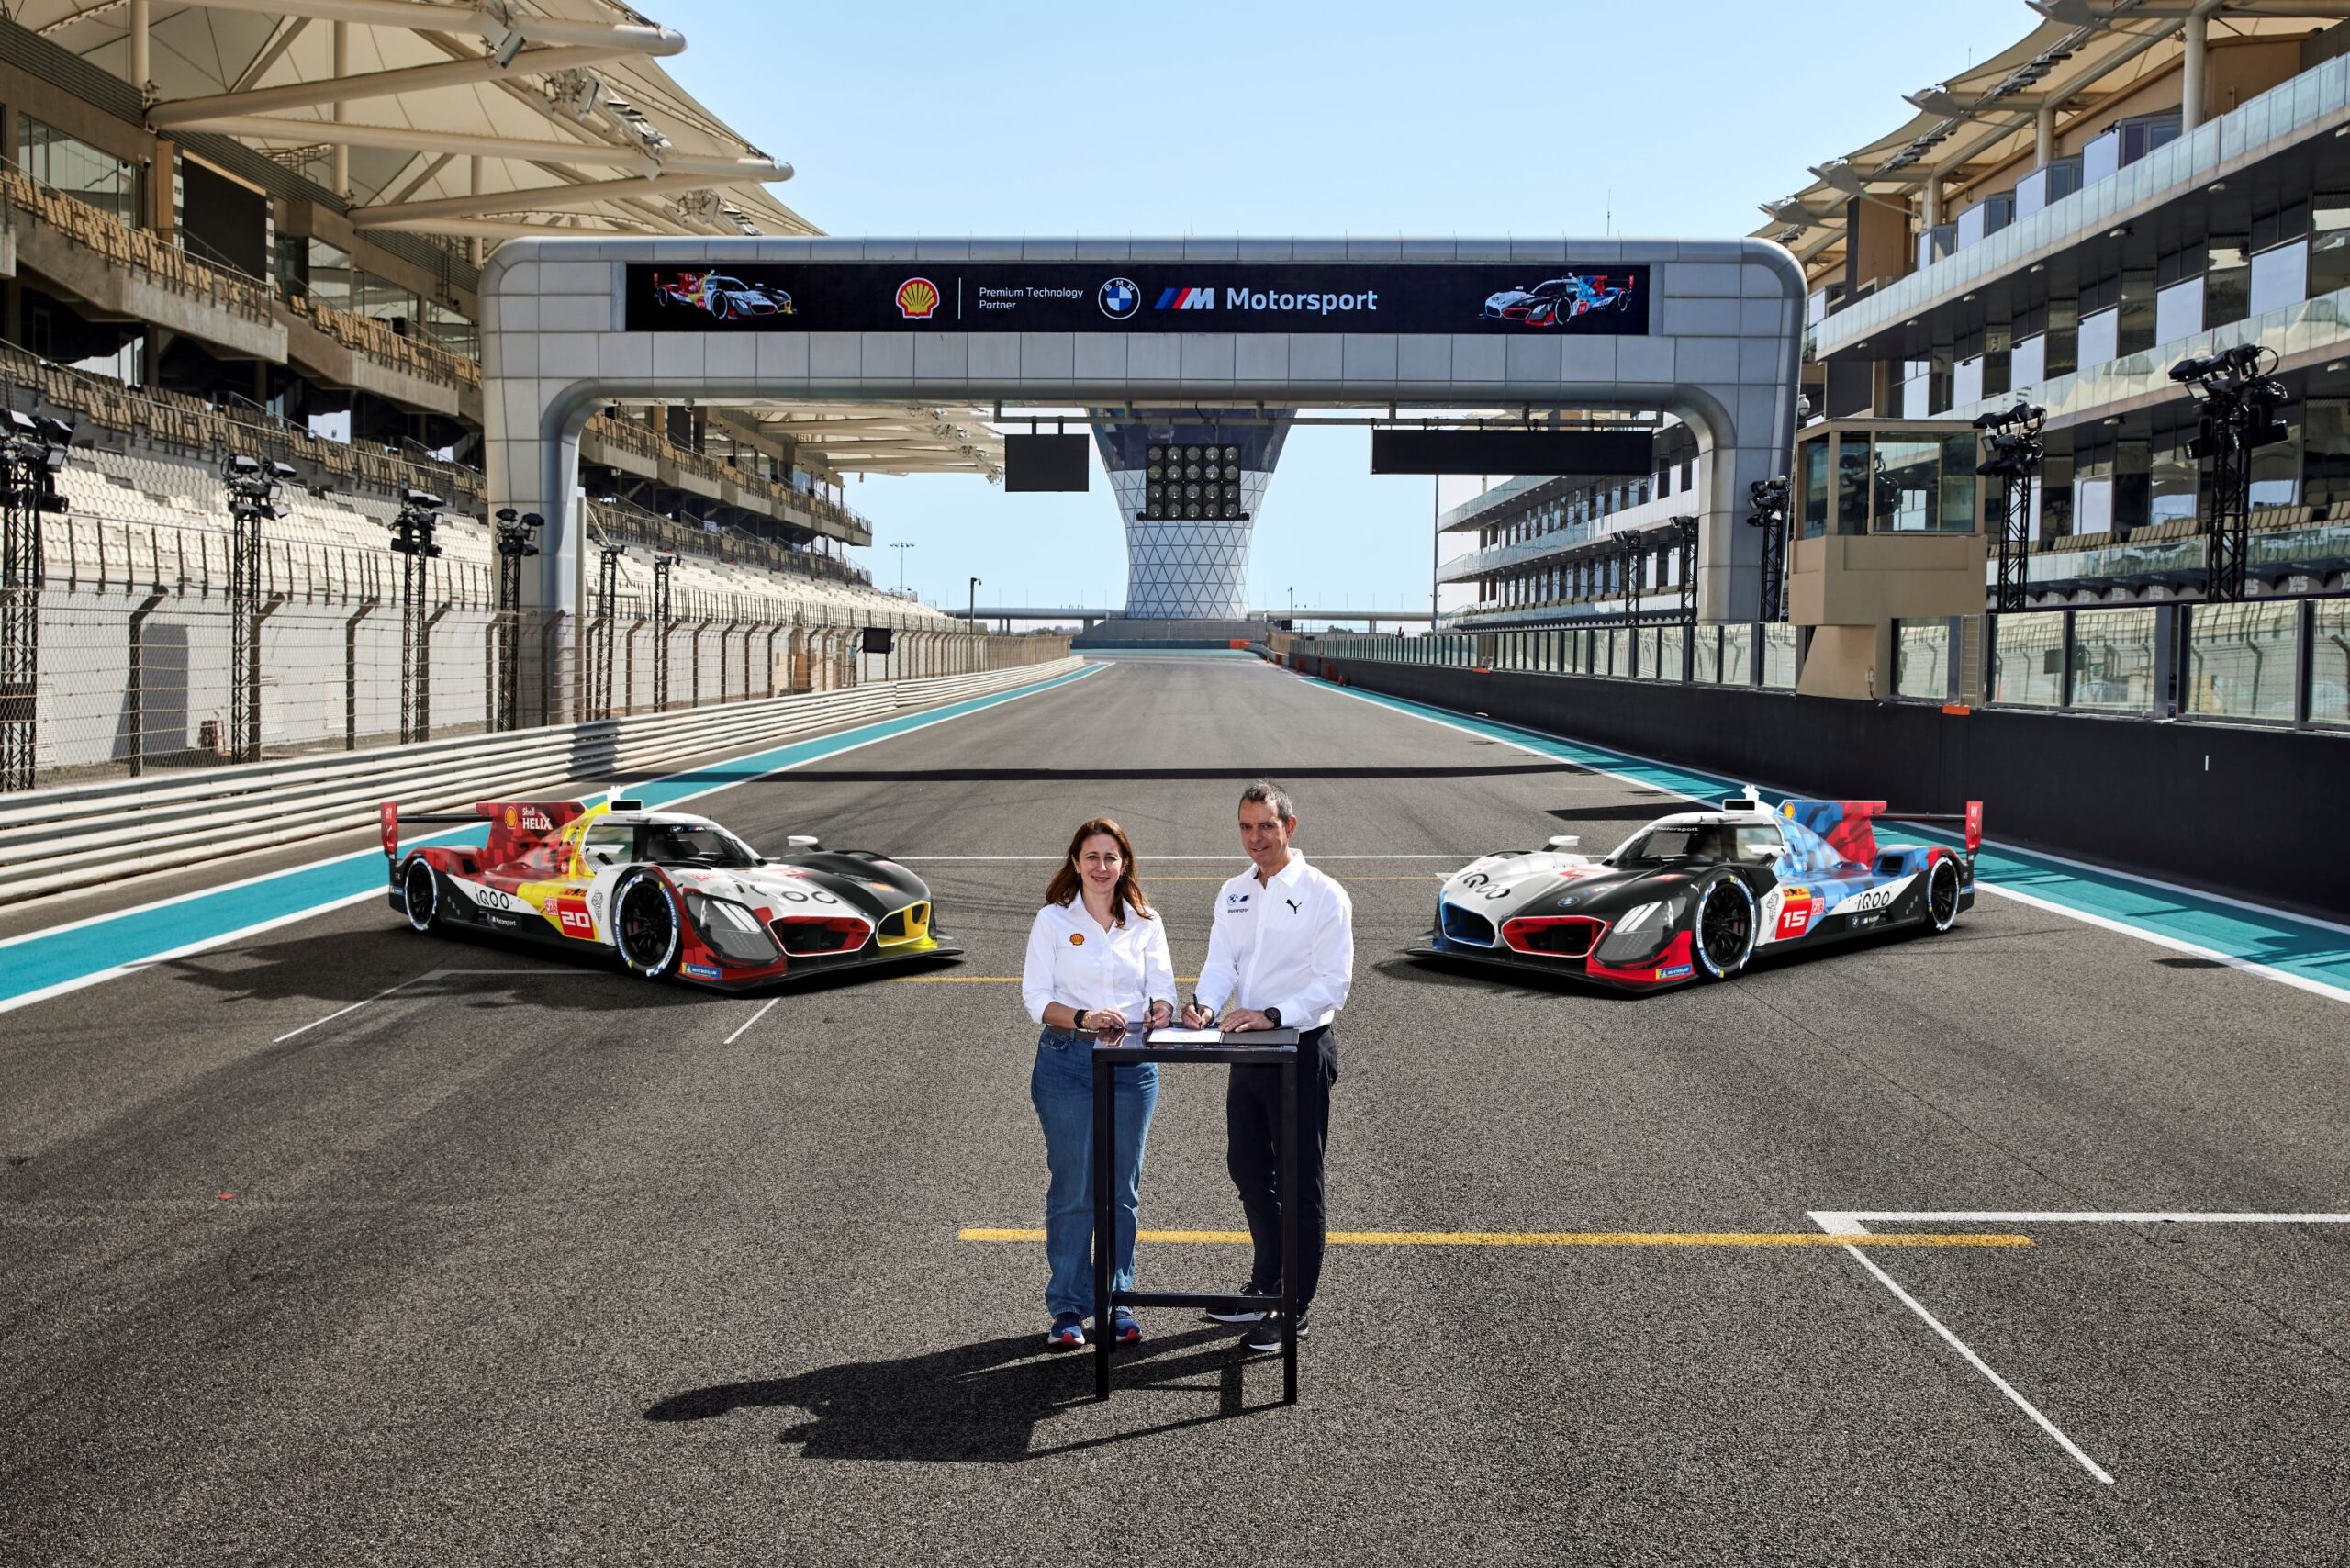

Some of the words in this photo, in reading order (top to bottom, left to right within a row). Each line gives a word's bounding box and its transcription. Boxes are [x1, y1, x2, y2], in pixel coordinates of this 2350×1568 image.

[979, 286, 1024, 297] Premium
[1025, 286, 1084, 299] Technology
[1226, 287, 1377, 315] Motorsport
[979, 299, 1017, 309] Partner
[2288, 576, 2308, 593] YAS
[521, 807, 536, 816] Shell
[521, 815, 554, 831] HELIX
[475, 885, 510, 910] iQOO
[1856, 890, 1891, 911] iQOO
[560, 911, 591, 928] 20
[1783, 910, 1807, 928] 15
[691, 967, 718, 975] MICHELIN
